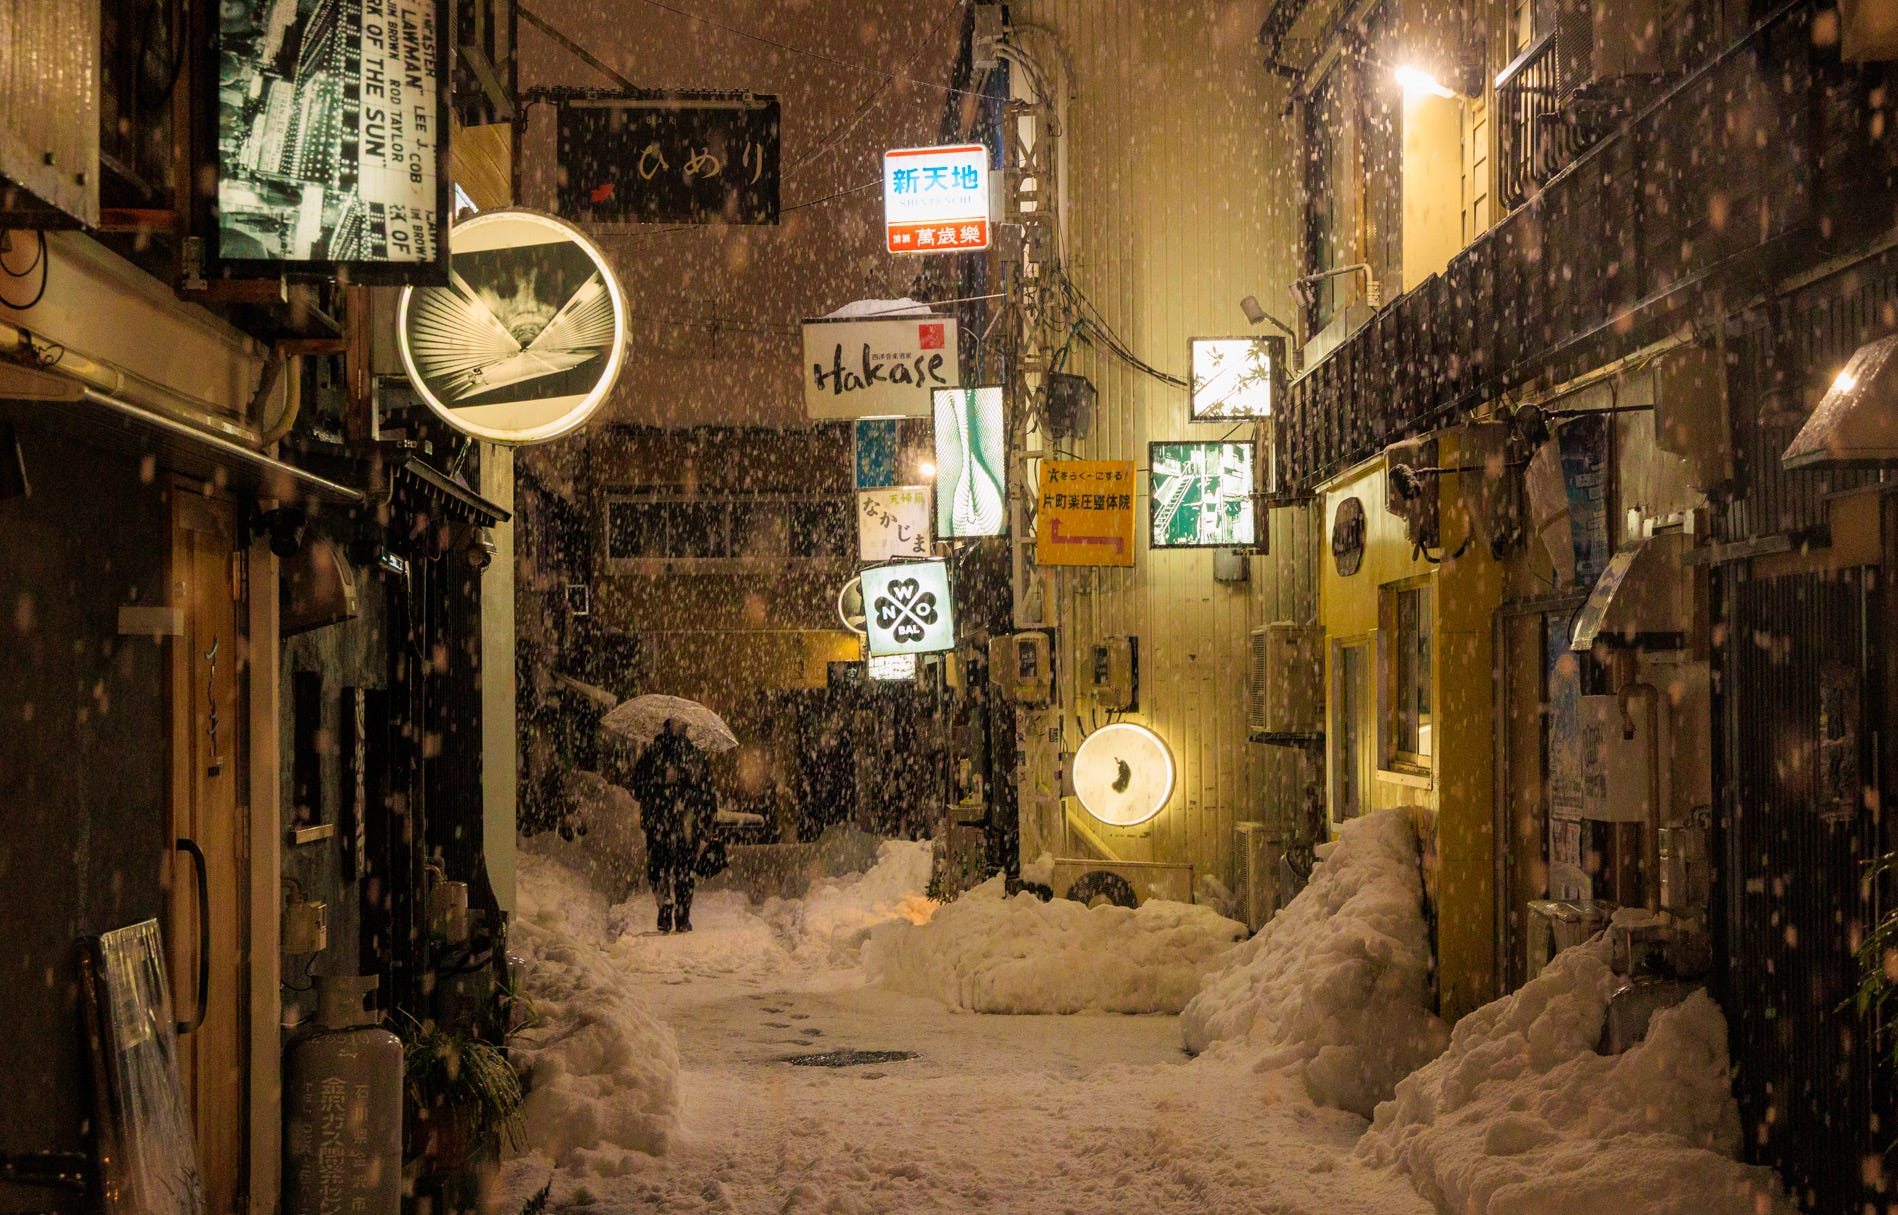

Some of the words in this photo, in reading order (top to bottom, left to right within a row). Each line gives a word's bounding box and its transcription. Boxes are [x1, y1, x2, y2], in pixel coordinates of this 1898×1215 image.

[366, 23, 384, 51] OF
[387, 21, 400, 61] BROWN
[365, 58, 385, 99] THE
[390, 79, 402, 105] ROD
[414, 105, 428, 133] LEE
[390, 111, 404, 163] TAYLOR
[639, 141, 763, 185] ひめり
[893, 165, 979, 194] 新天地
[391, 229, 410, 256] OF
[814, 343, 946, 395] Hakase
[1043, 493, 1130, 511] 片町楽圧整体院
[863, 497, 926, 553] なかじま
[898, 624, 921, 636] BAL
